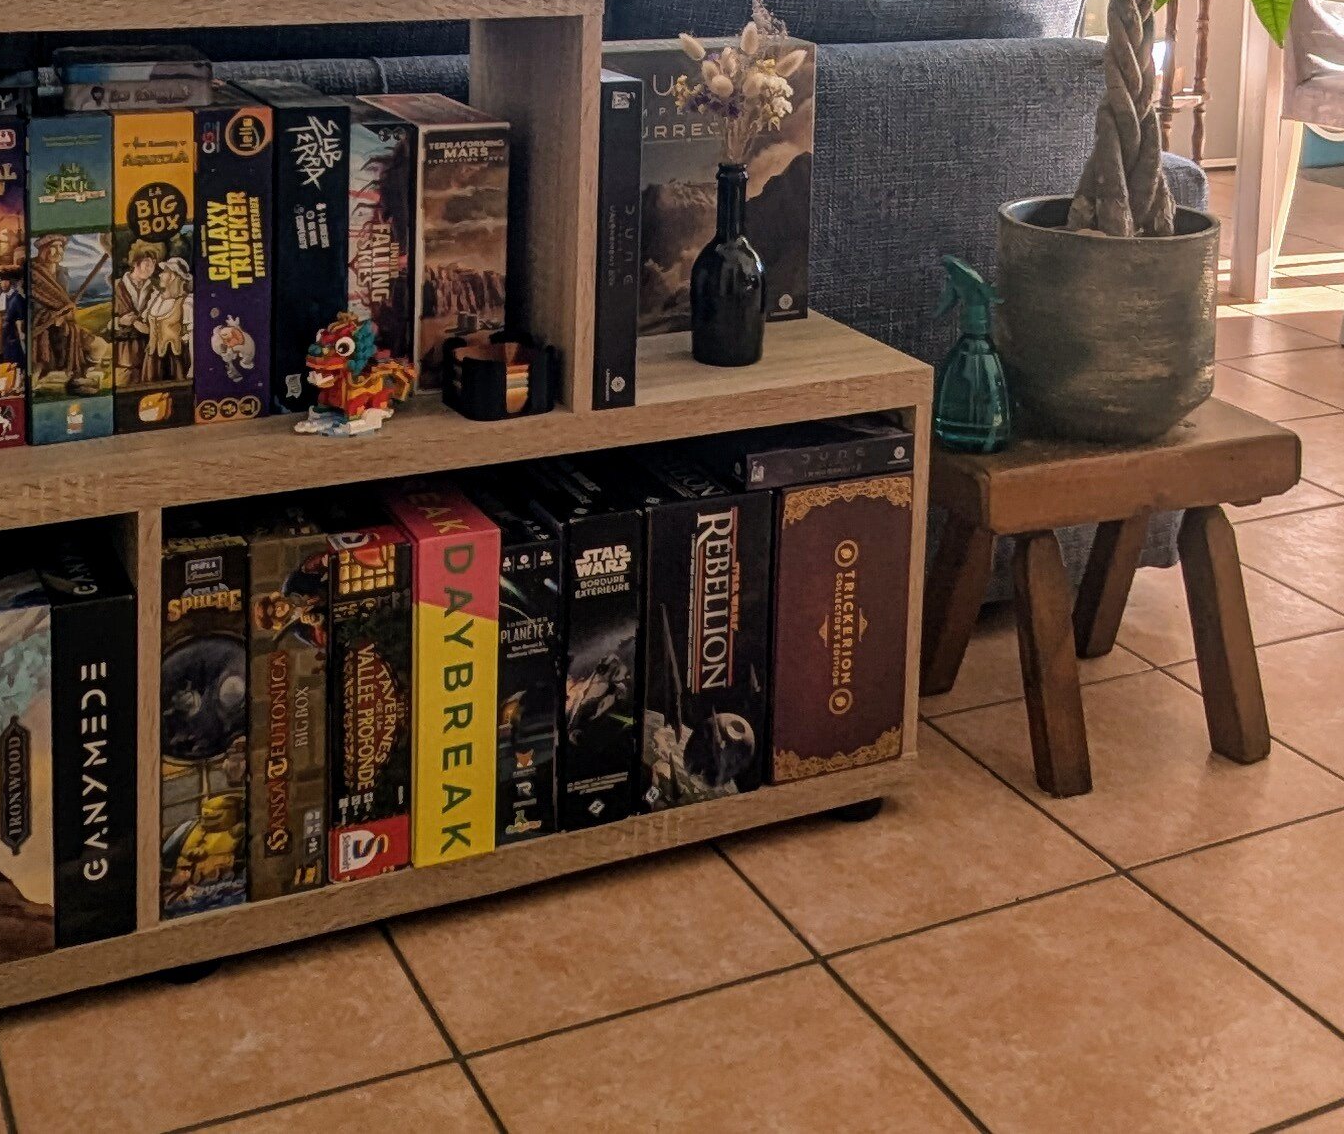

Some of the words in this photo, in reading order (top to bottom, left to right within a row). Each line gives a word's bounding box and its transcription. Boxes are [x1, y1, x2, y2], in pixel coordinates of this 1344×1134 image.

[428, 138, 506, 151] TERRAFORMING
[443, 147, 490, 159] MARS
[135, 195, 178, 217] BIG
[137, 213, 181, 237] BOX
[206, 200, 231, 281] GALAXY
[229, 190, 253, 289] TRUCKER
[357, 239, 373, 289] SKIES
[372, 221, 392, 303] FALLING
[574, 557, 629, 578] WARS
[579, 574, 626, 590] BORDURE
[580, 544, 632, 564] STAR
[696, 507, 734, 689] RÉBELLION
[840, 569, 855, 685] TRICKERION
[293, 685, 310, 718] BOX
[356, 642, 376, 704] VALLÉE
[440, 542, 476, 855] DAYBREAK
[266, 653, 288, 780] TEUTONICA
[294, 719, 309, 749] BIG
[373, 663, 398, 765] TAVERNES
[80, 661, 109, 883] GANYMEDE
[355, 708, 376, 792] PROFONDE
[7, 736, 23, 837] IRONWOOD
